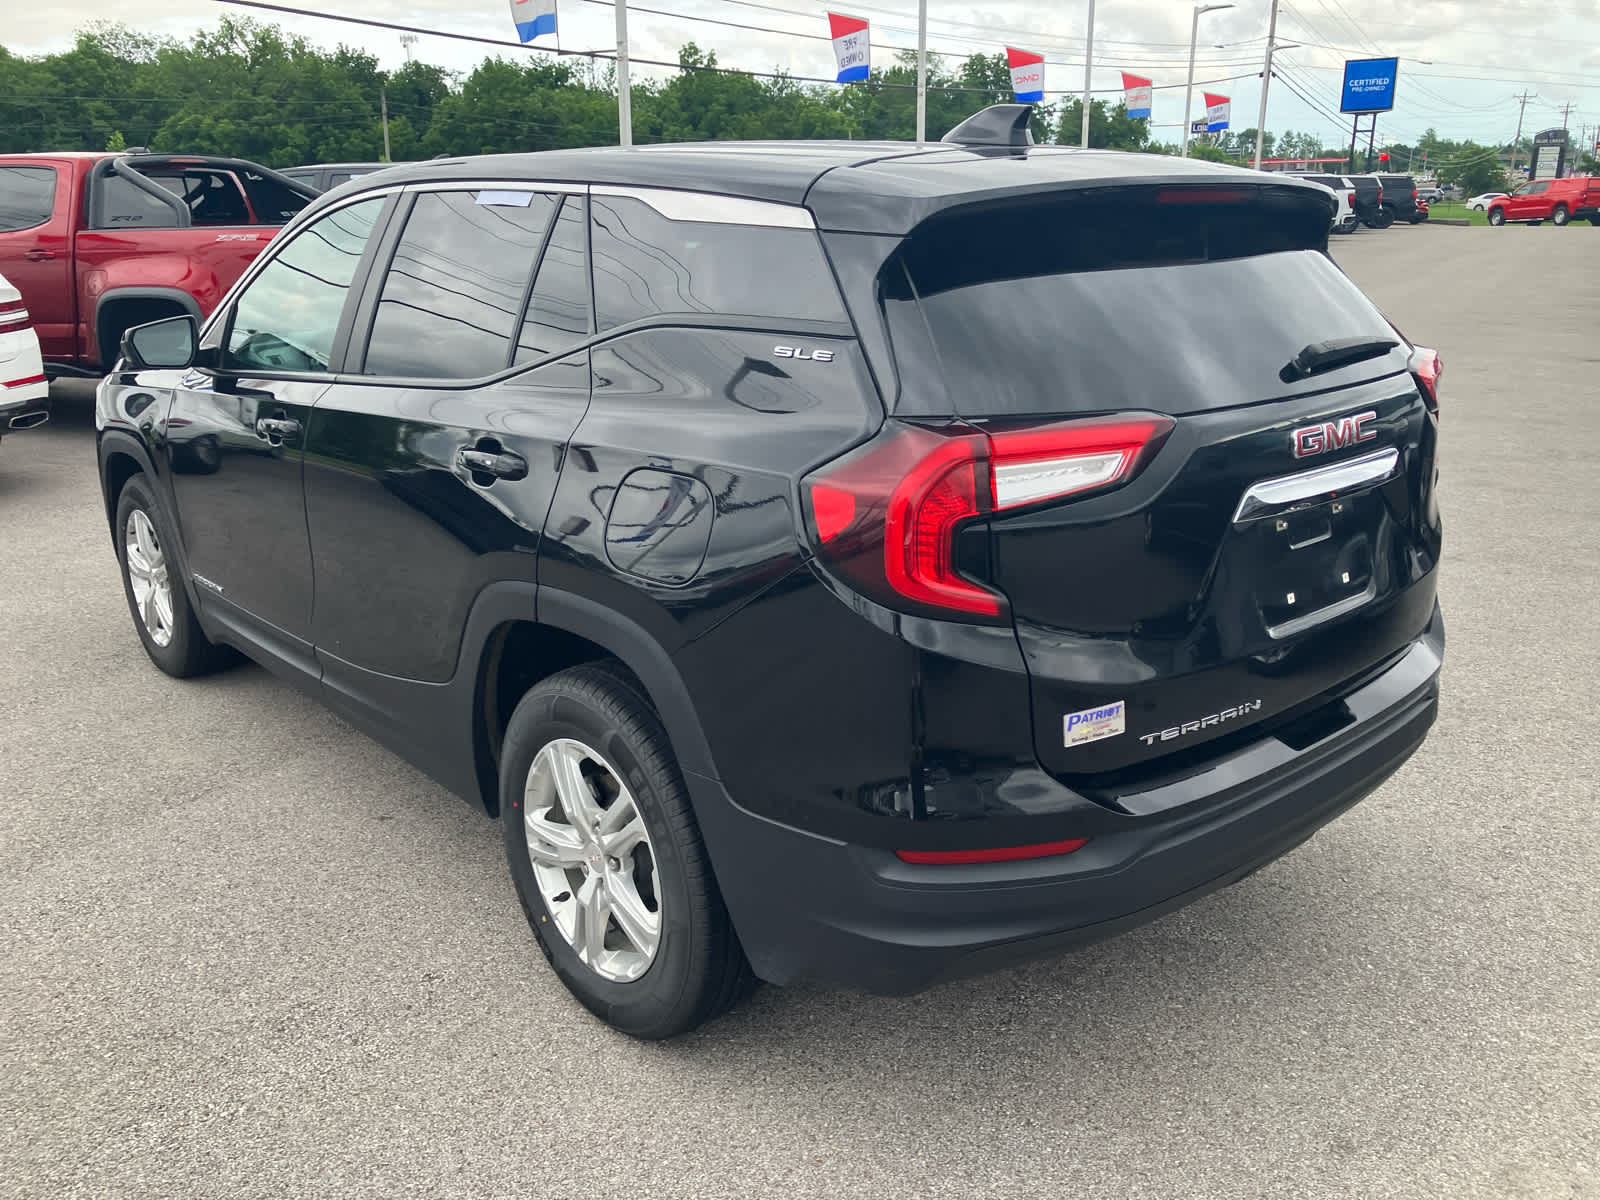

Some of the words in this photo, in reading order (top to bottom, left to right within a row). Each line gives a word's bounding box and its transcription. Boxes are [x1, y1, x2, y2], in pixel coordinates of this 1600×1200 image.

[1349, 77, 1390, 87] CERTIFIED
[773, 345, 834, 362] SLE
[1292, 410, 1377, 459] GMC
[1067, 704, 1122, 732] PATRIOT
[1138, 699, 1263, 745] TERRAIN
